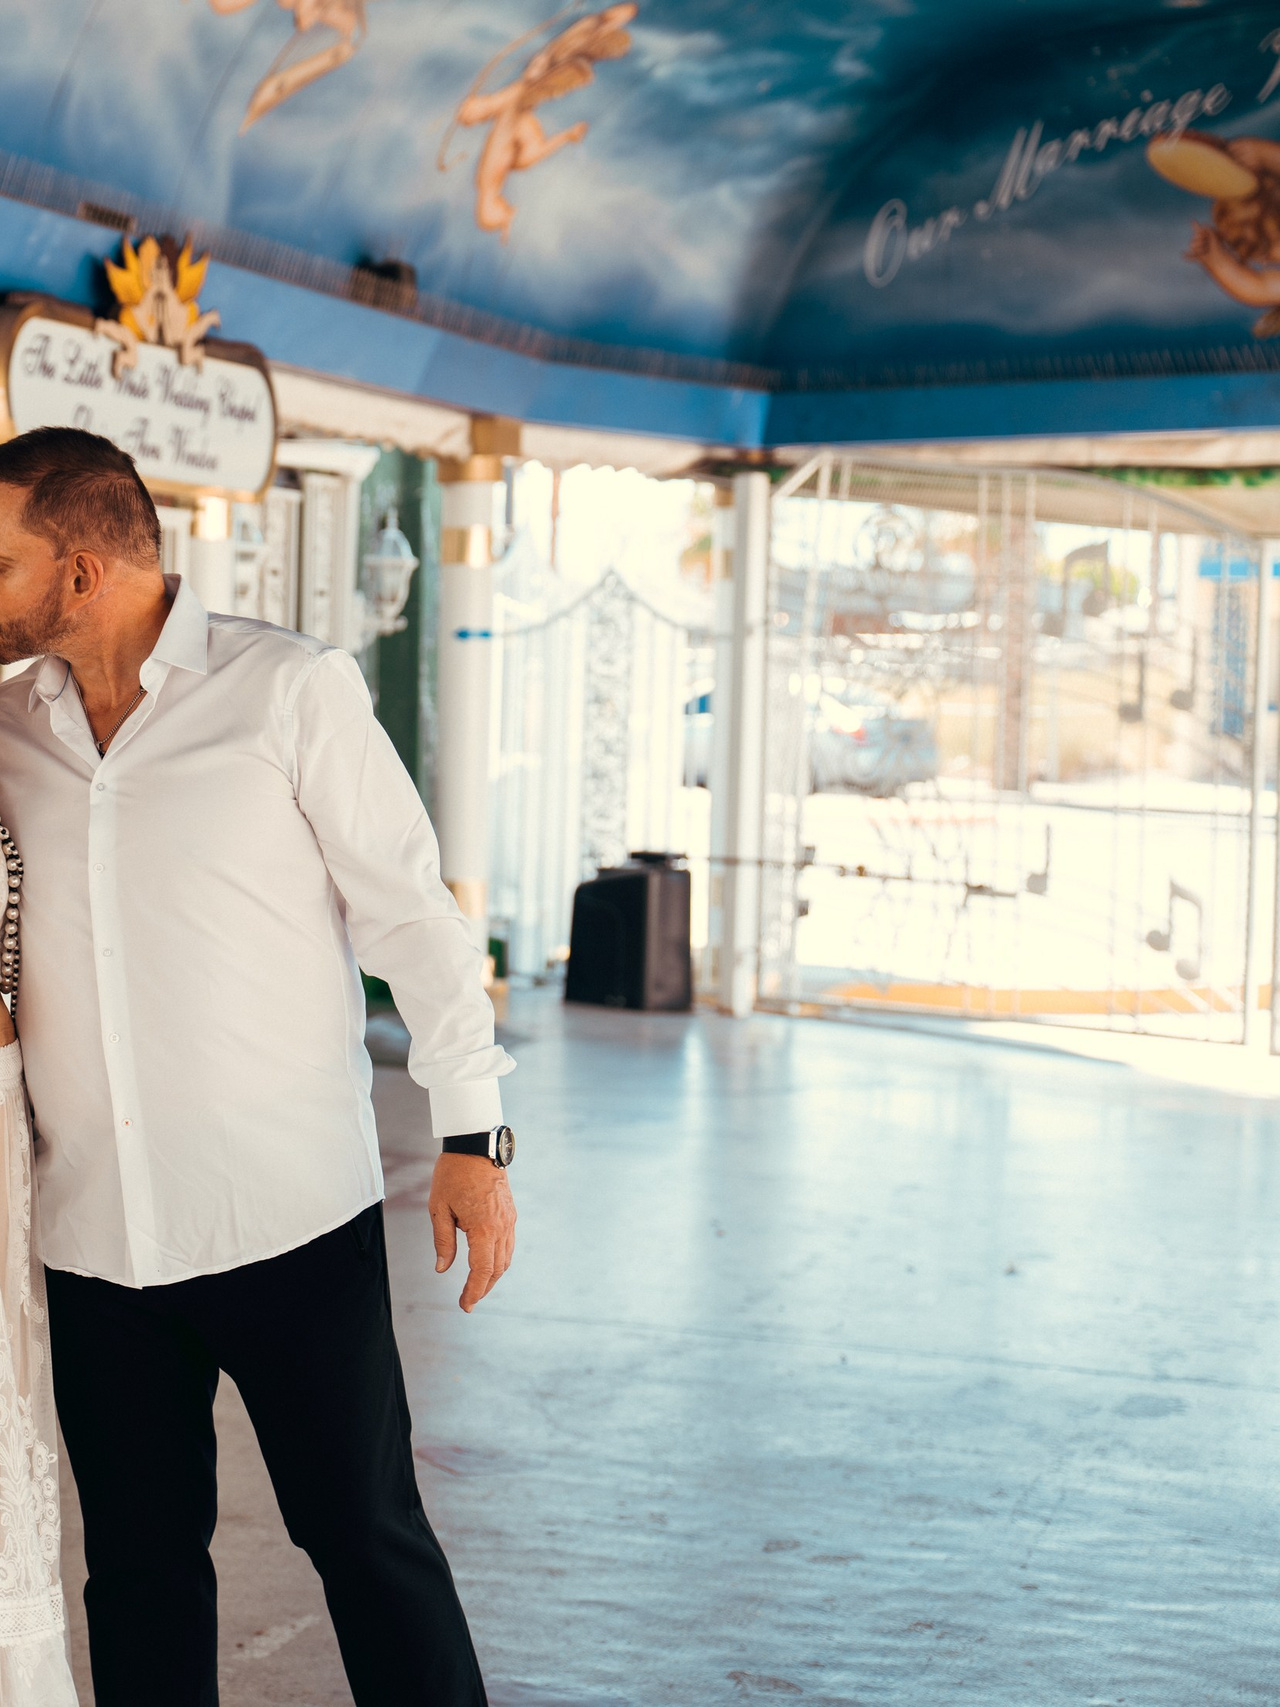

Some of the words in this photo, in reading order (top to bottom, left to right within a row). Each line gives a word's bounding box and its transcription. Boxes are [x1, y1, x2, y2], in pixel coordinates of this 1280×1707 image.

[863, 198, 967, 289] Our
[973, 82, 1232, 219] Marriage
[21, 333, 56, 380] The
